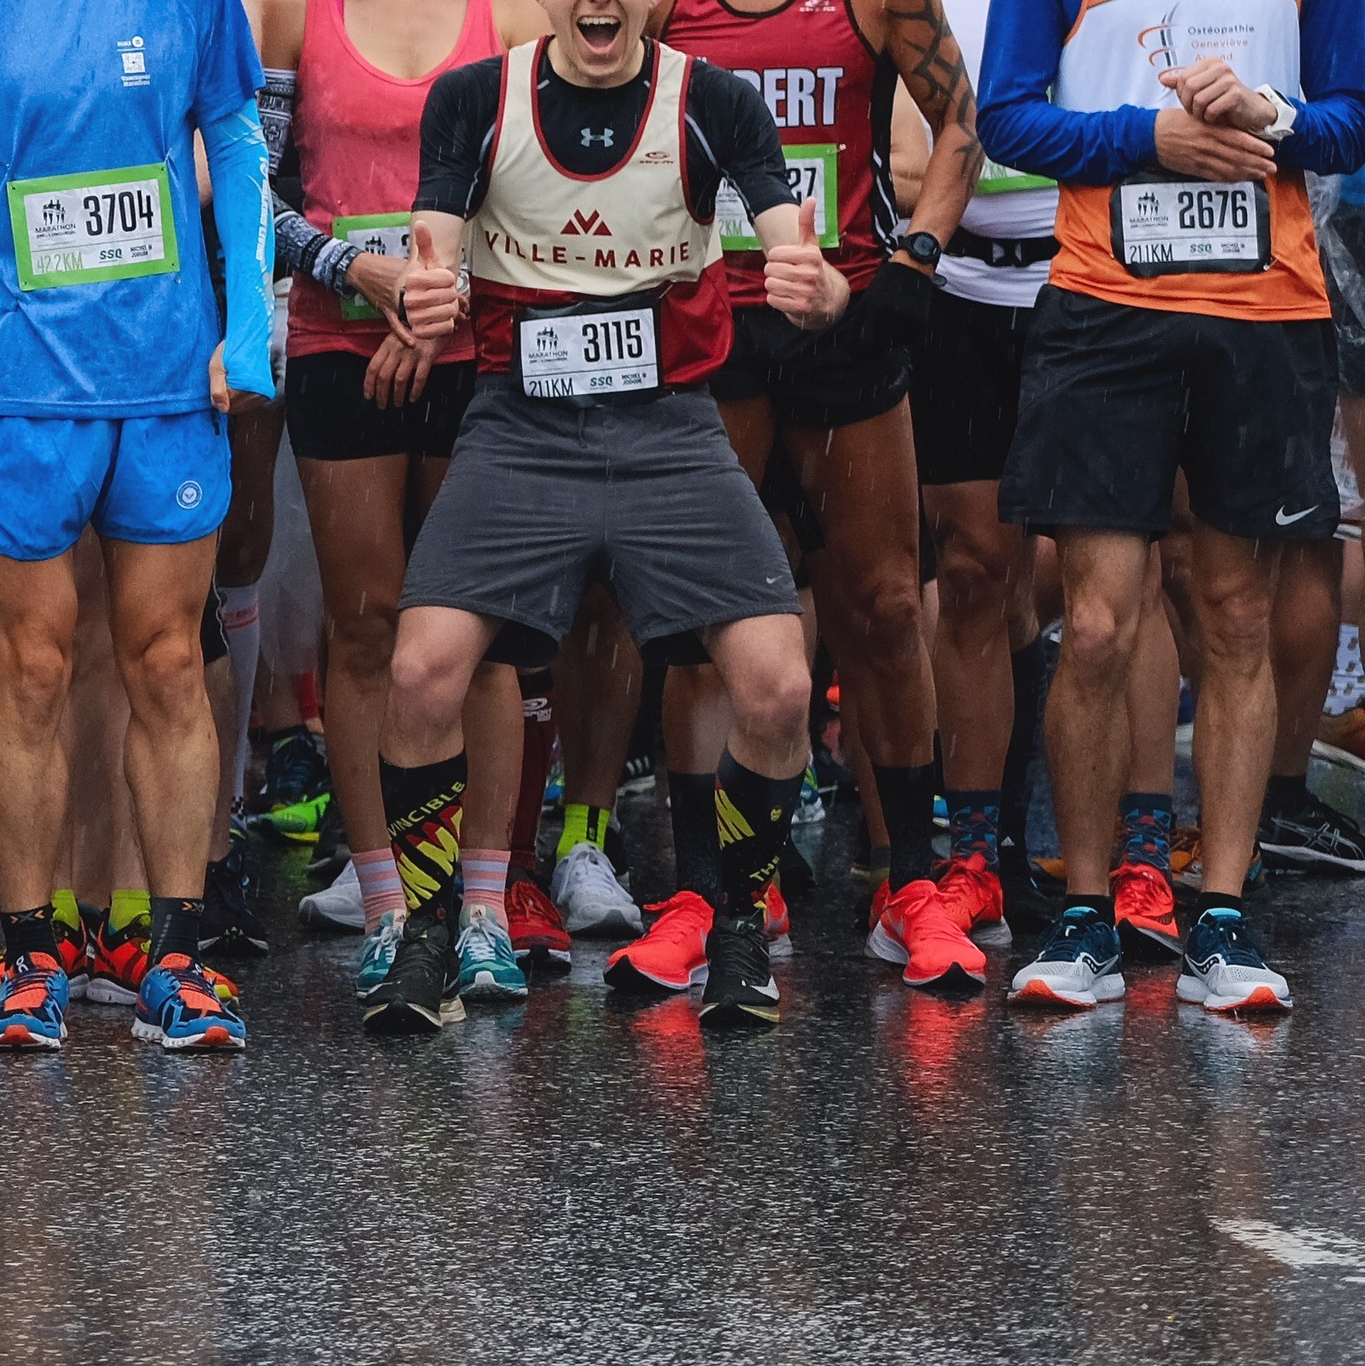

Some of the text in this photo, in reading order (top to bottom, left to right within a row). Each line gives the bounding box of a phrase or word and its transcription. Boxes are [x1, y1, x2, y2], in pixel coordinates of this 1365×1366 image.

[83, 189, 154, 236] 3704
[1177, 190, 1249, 230] 2676
[581, 318, 643, 363] 3115
